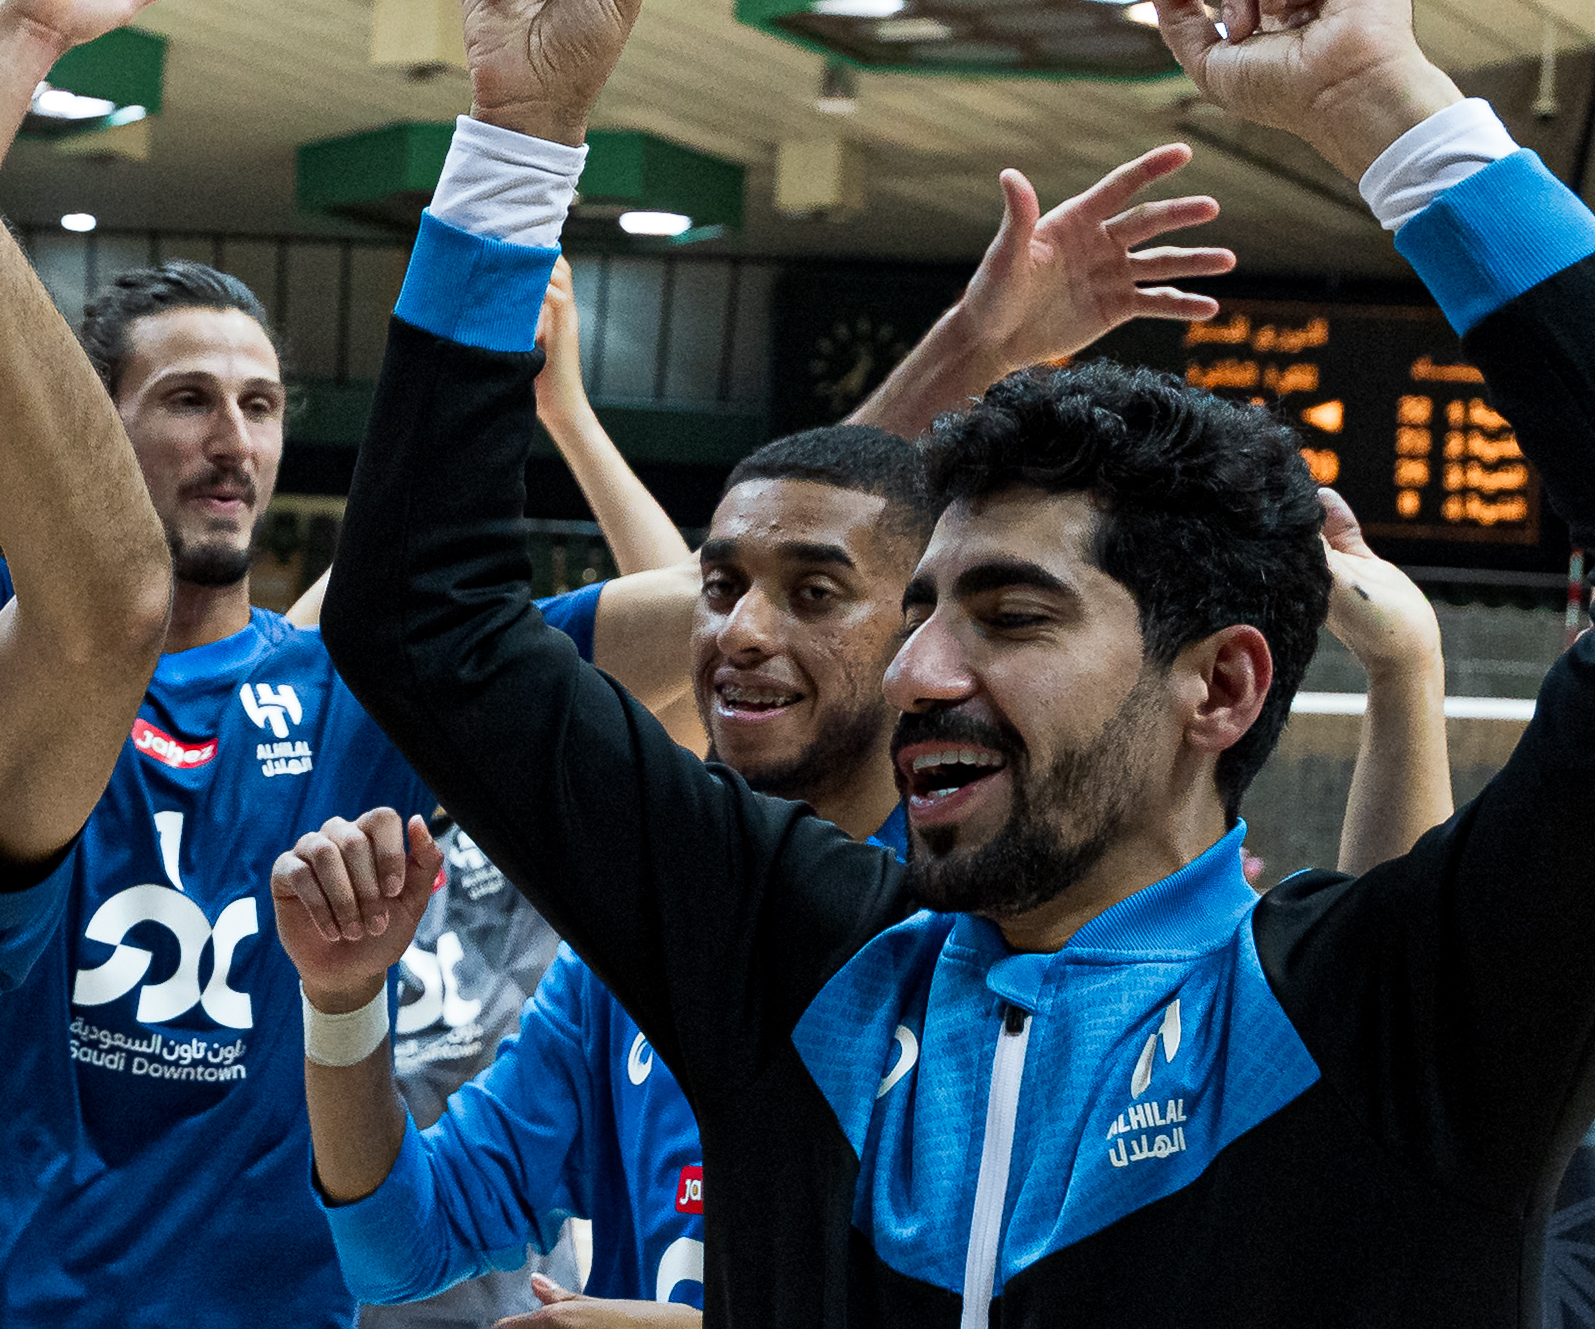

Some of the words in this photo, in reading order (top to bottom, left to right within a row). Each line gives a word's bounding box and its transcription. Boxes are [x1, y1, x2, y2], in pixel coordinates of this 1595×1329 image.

[132, 1057, 246, 1081] Downtown
[1106, 1099, 1186, 1140] ALHILAL
[1109, 1127, 1186, 1167] الهلال
